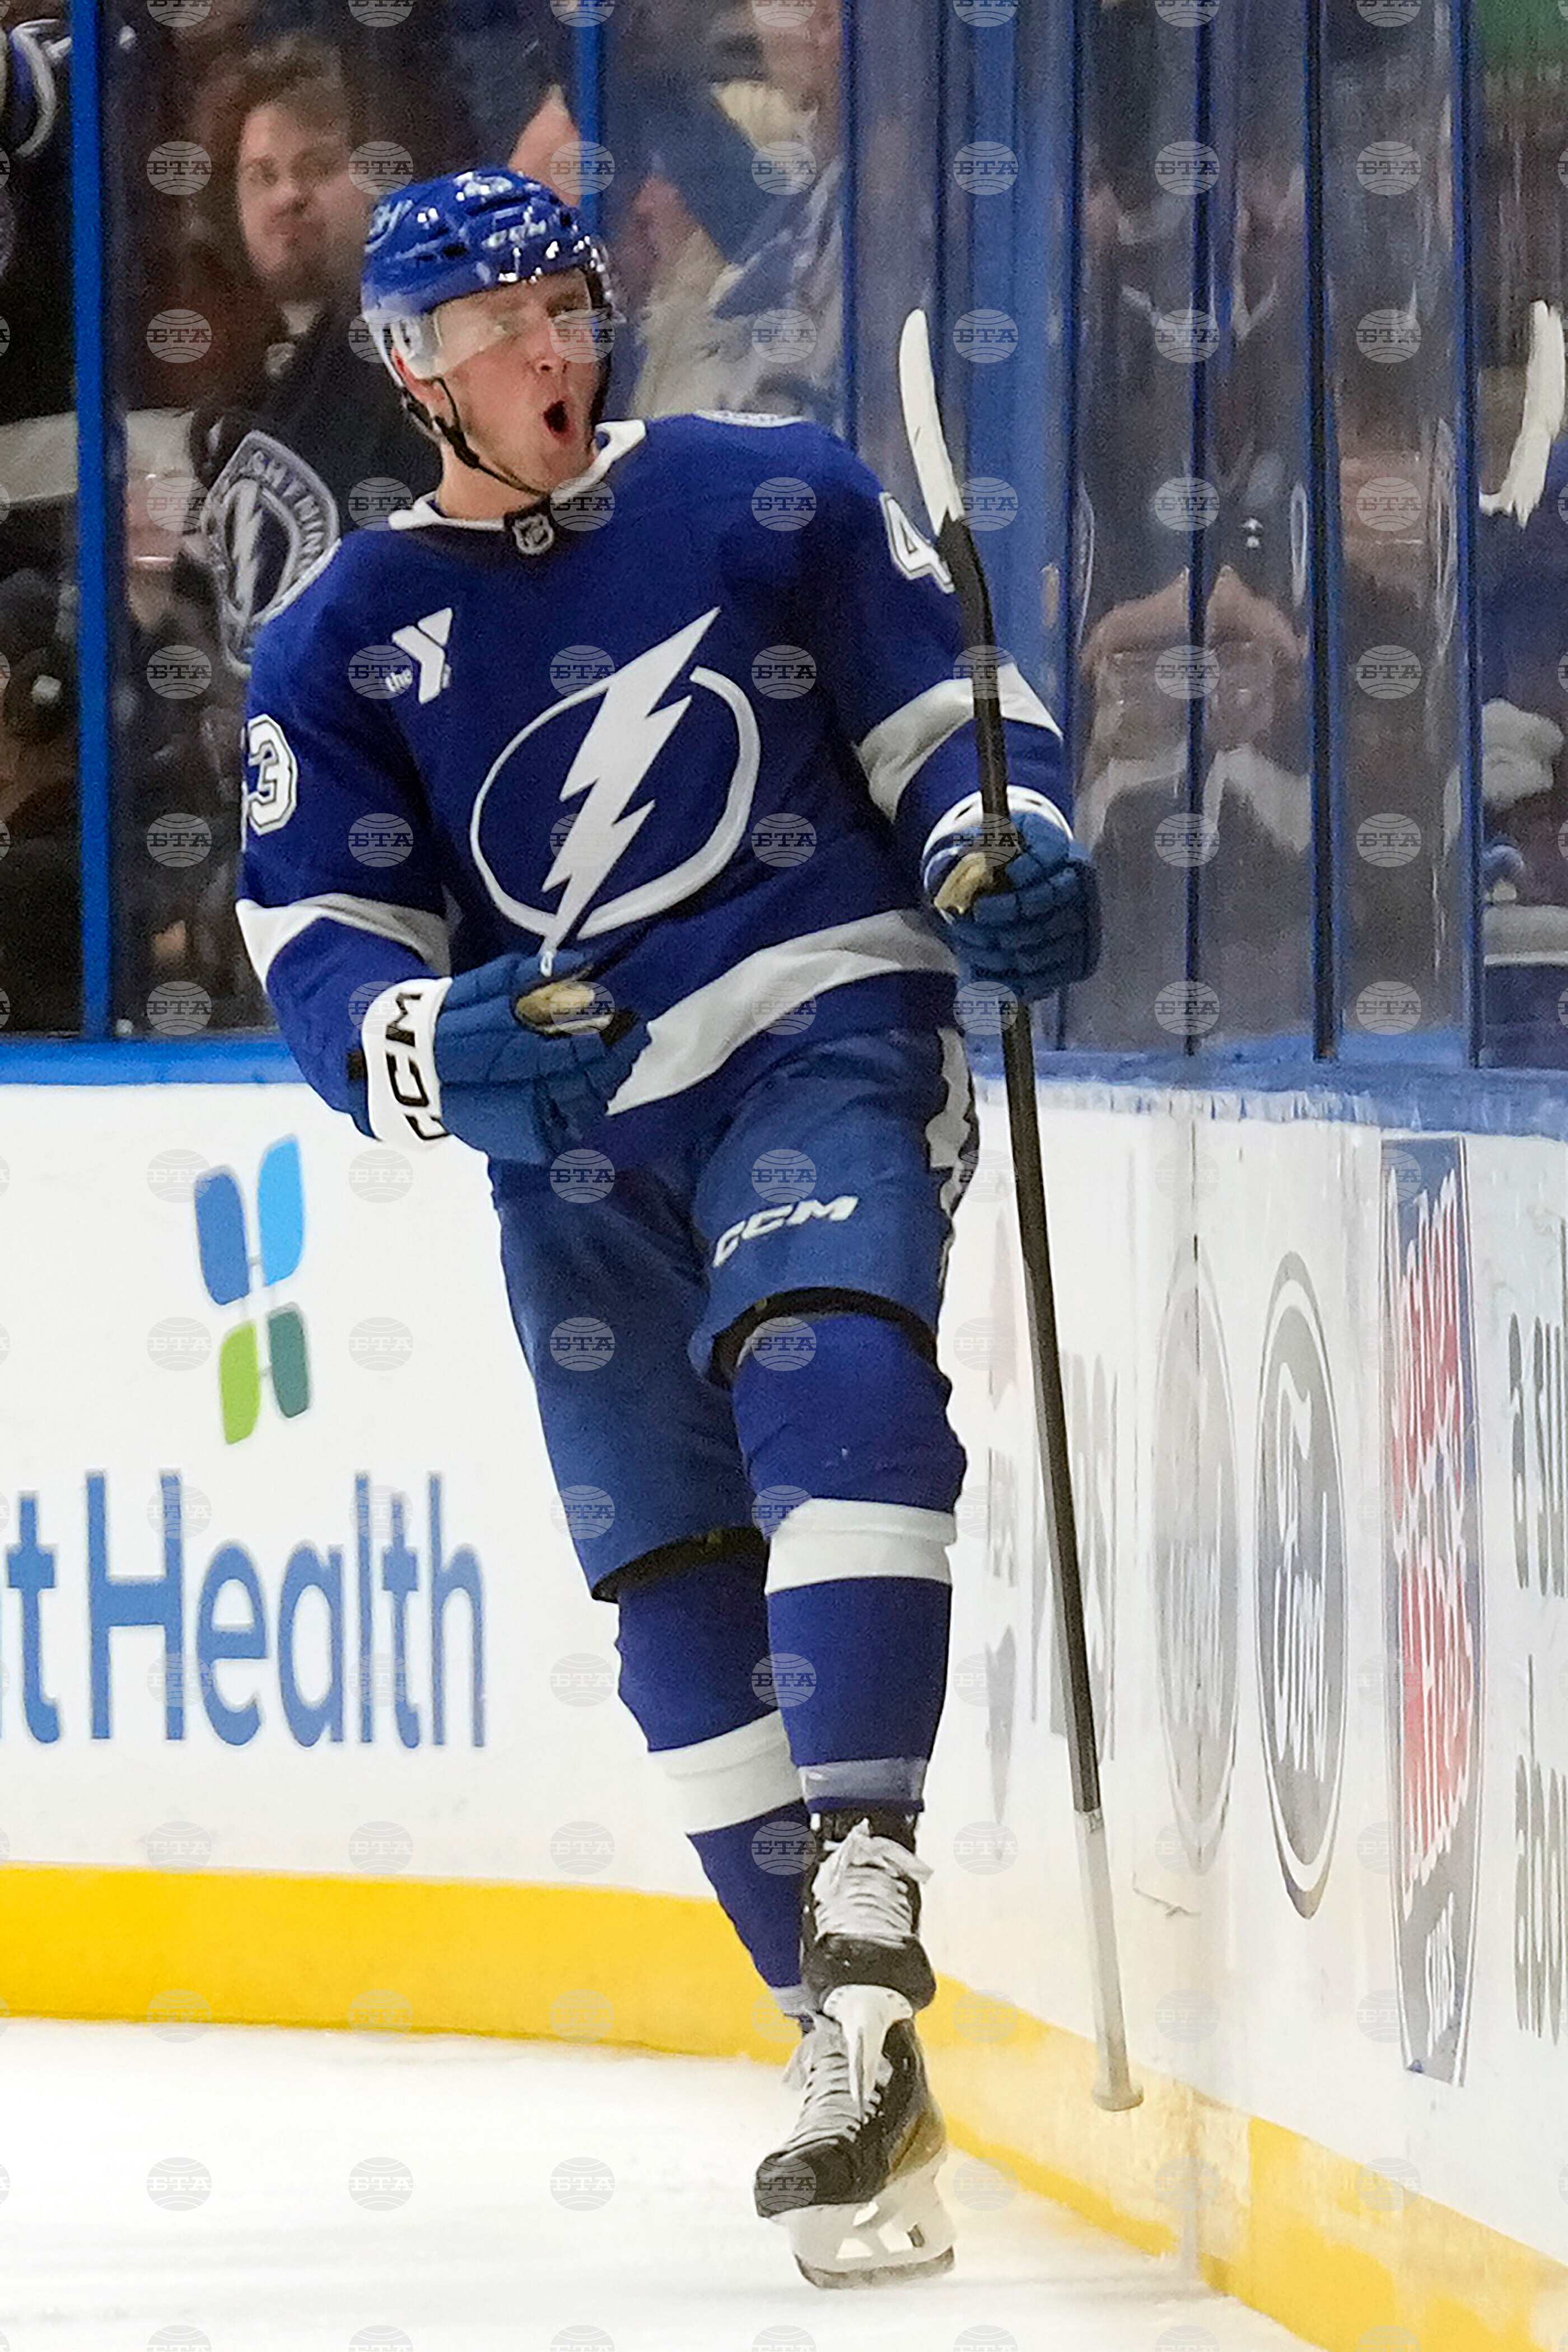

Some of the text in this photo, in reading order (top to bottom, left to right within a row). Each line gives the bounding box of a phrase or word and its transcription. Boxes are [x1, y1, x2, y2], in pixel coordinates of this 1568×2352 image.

[240, 713, 298, 850] 3
[384, 992, 450, 1141] CCM
[712, 1194, 860, 1268] CCM
[1508, 1312, 1529, 1589] a
[1273, 1361, 1329, 1782] Ford
[1425, 1891, 1455, 2057] SUBS
